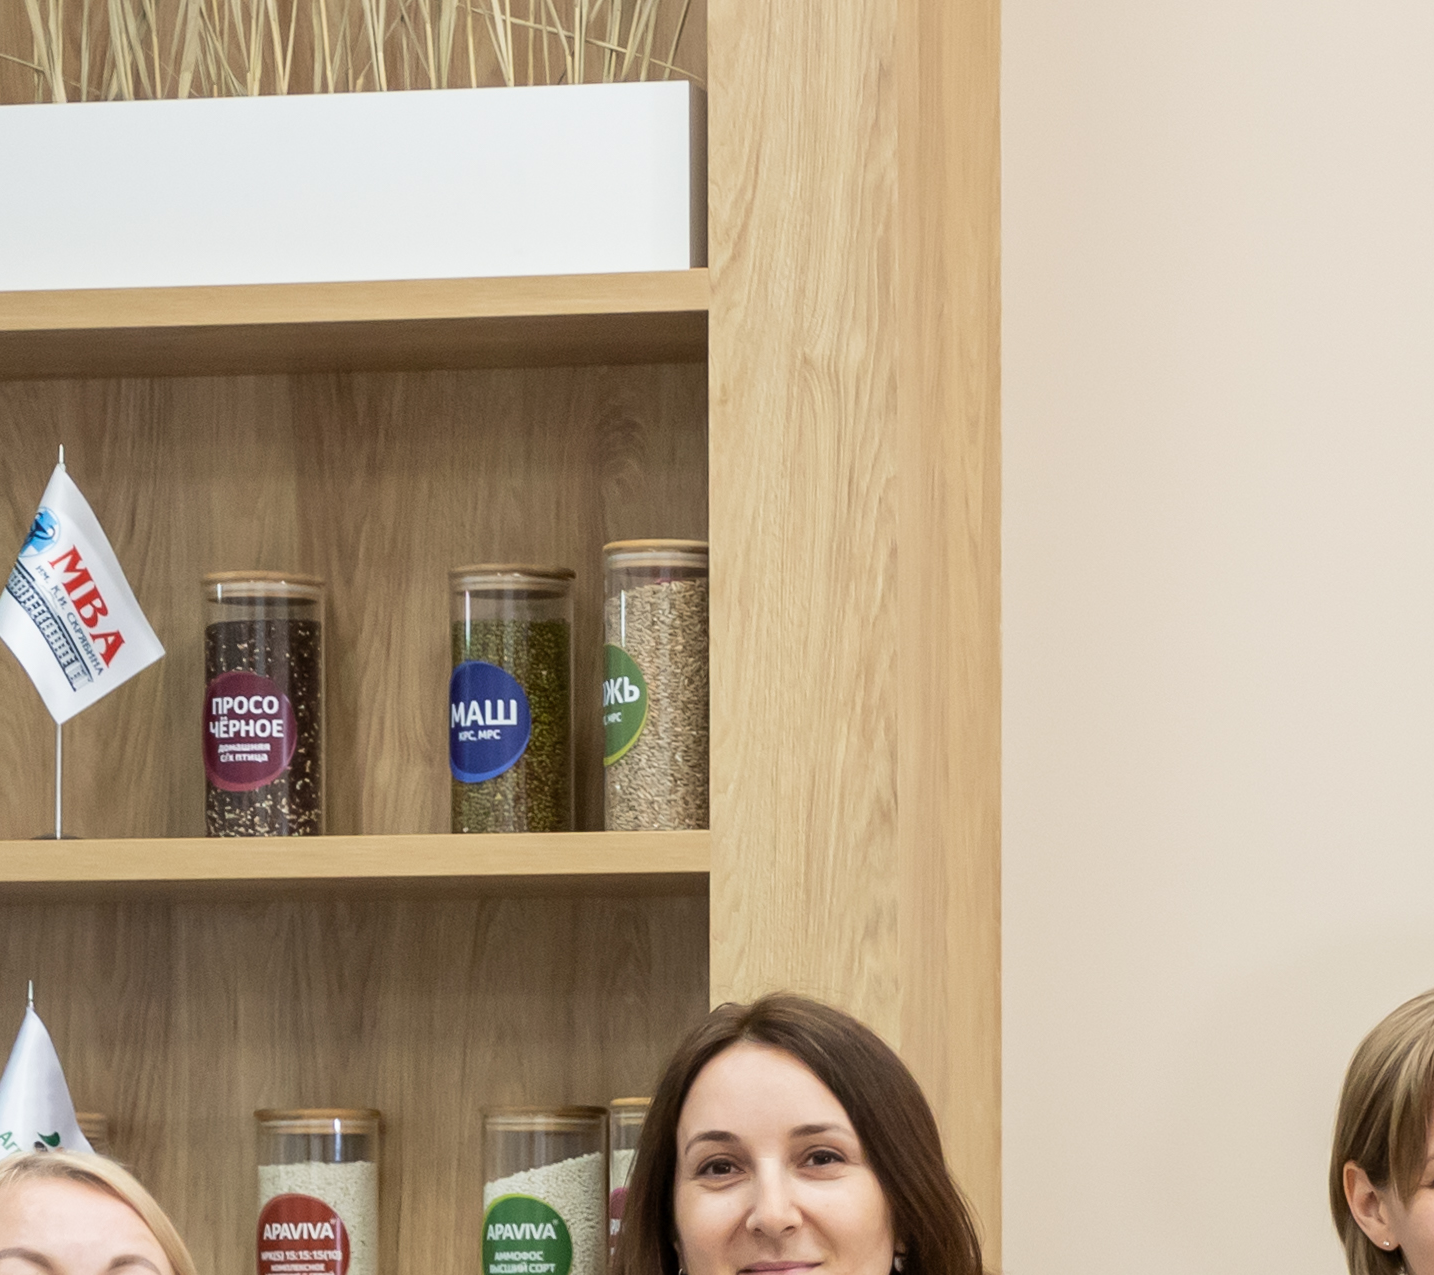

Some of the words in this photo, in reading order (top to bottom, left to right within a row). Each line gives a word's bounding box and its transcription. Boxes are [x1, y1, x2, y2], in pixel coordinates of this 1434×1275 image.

[212, 695, 279, 715] ПРОСО
[451, 699, 518, 728] МАШ
[209, 716, 284, 738] ЧЁРНОЕ
[263, 1222, 335, 1240] APAVIVA
[487, 1222, 557, 1241] APAVIVA
[494, 1251, 544, 1261] АММОФОС
[528, 1263, 556, 1274] СОРТ
